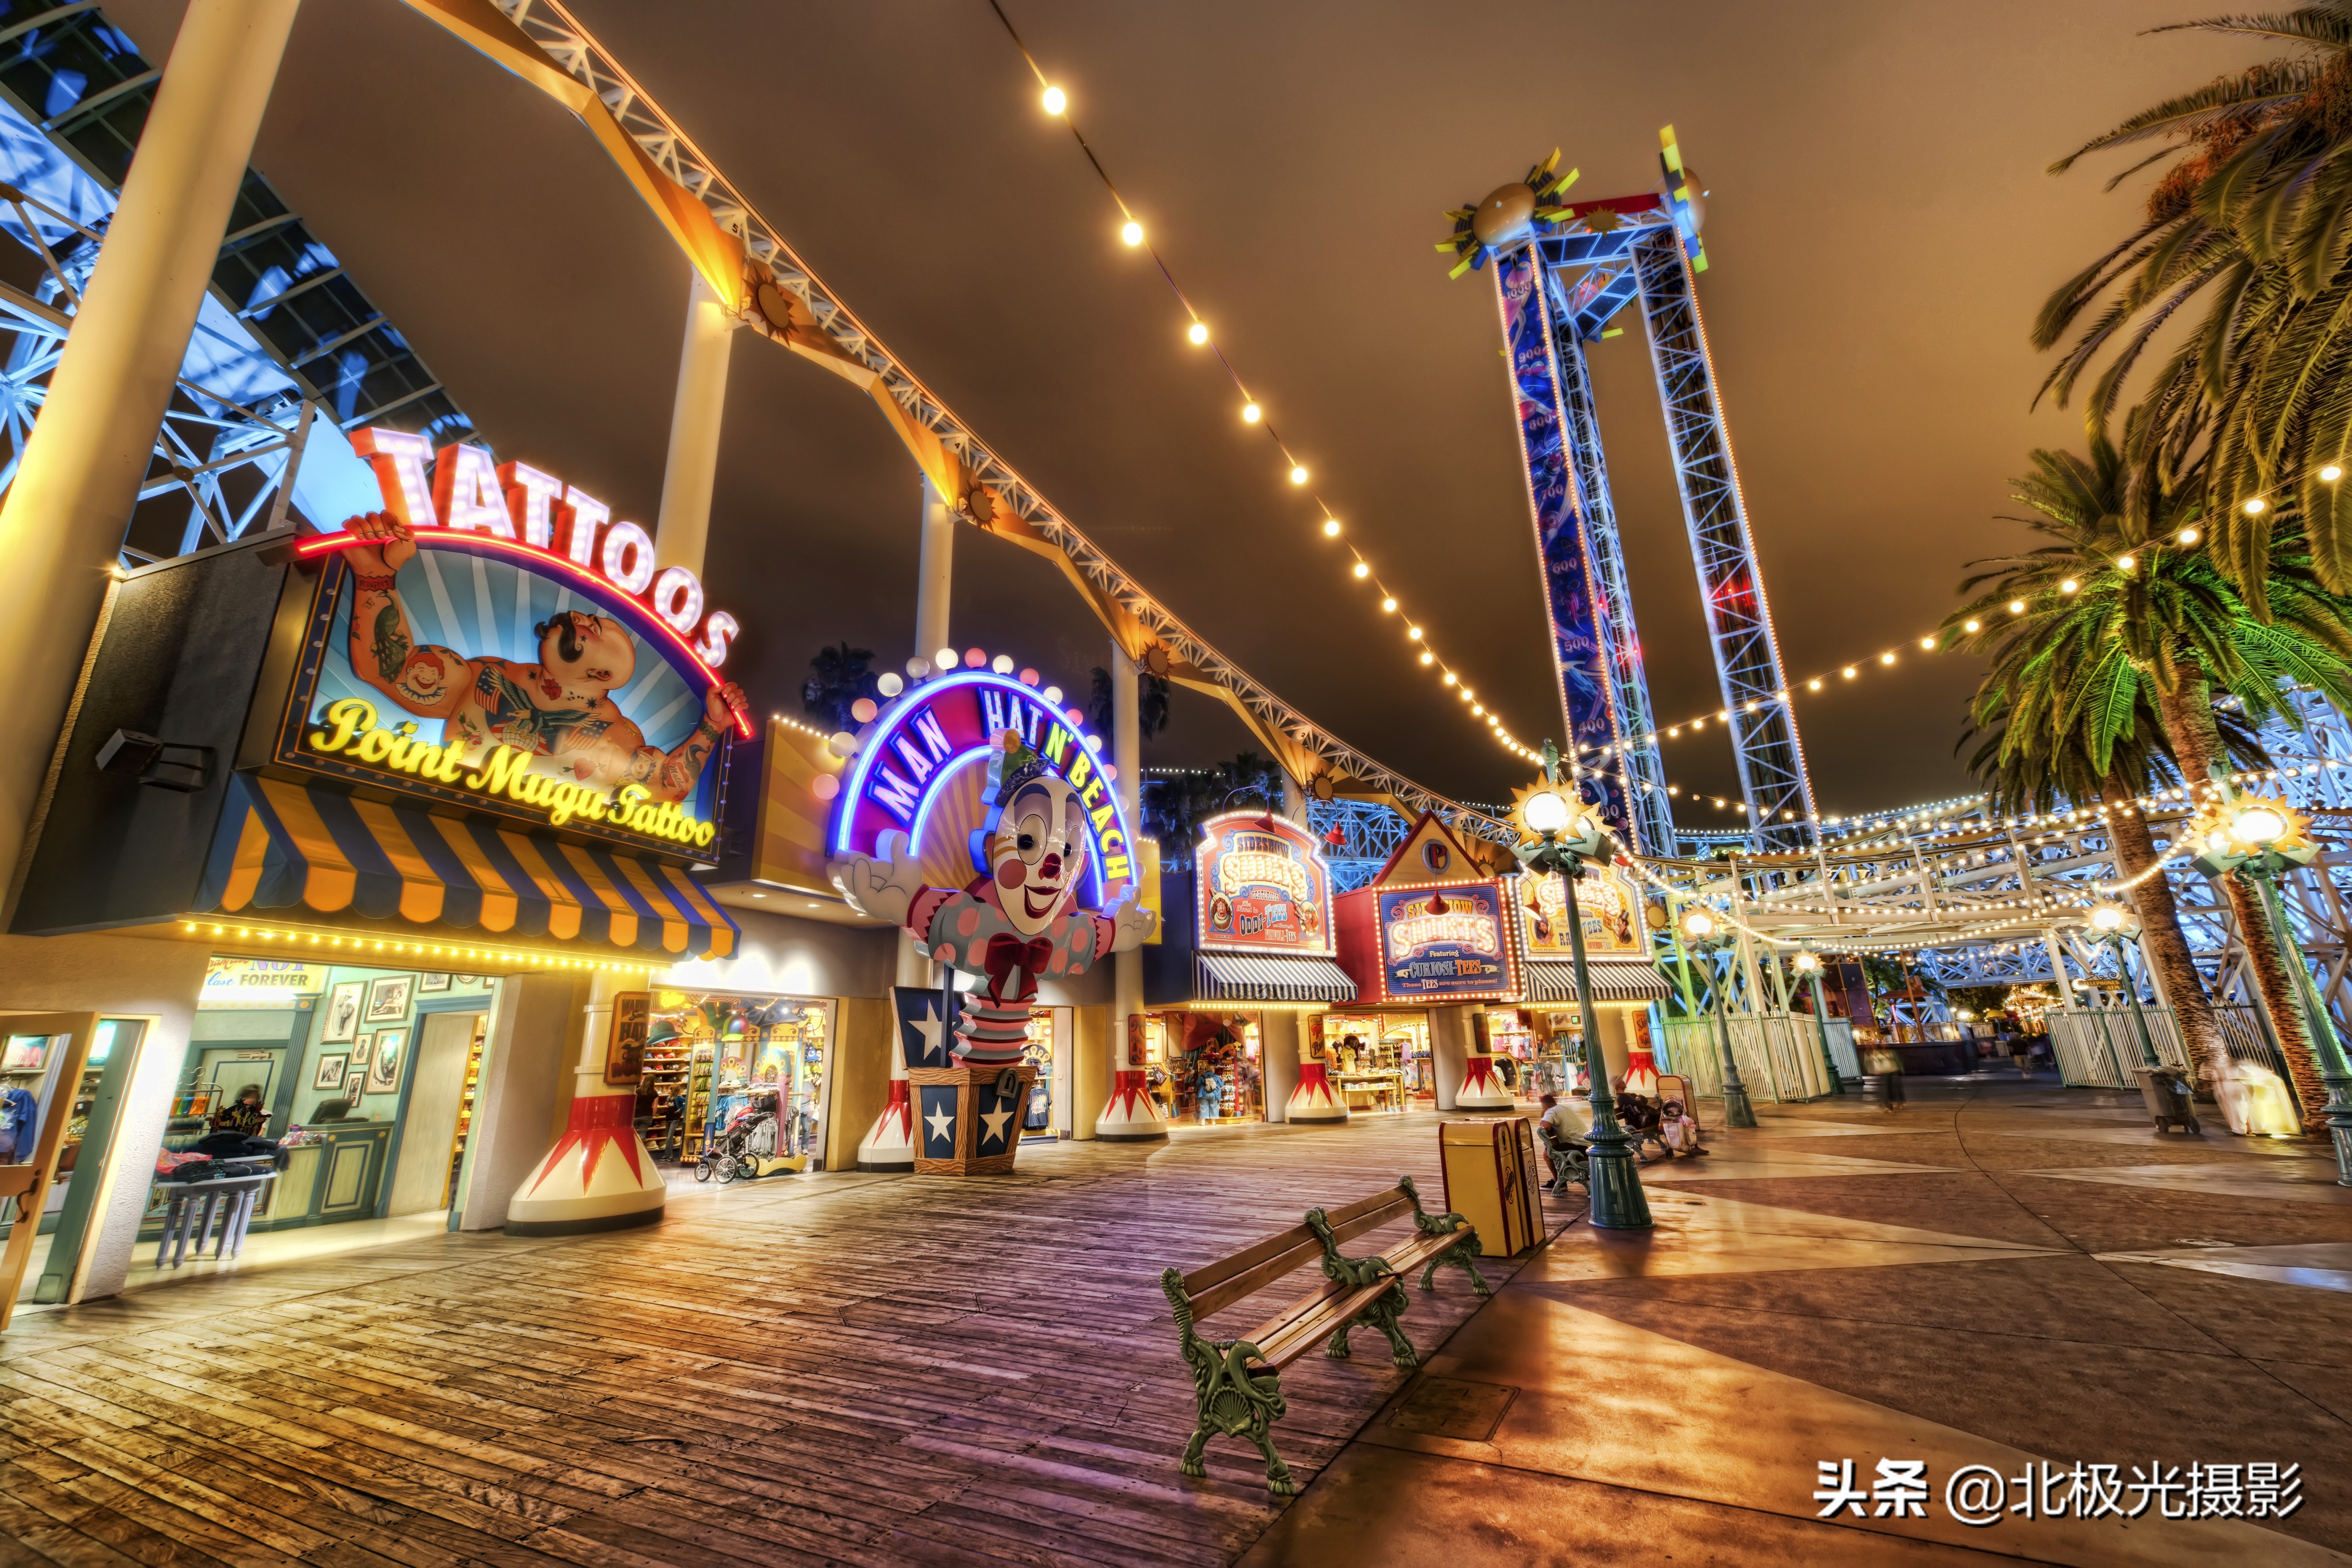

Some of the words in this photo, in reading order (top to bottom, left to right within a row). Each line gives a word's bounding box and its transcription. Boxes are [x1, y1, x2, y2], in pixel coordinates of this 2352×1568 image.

[1507, 281, 1532, 301] 1000
[1518, 346, 1541, 365] 900
[1529, 413, 1552, 431] 800
[1541, 483, 1564, 501] 700
[349, 427, 739, 668] TATTOOS
[1552, 557, 1577, 575] 600
[359, 579, 390, 588] RIGHT
[1564, 635, 1591, 654] 500
[702, 726, 714, 738] LEFT
[1578, 717, 1606, 736] 400
[310, 698, 469, 783] Point
[466, 743, 609, 825] Mugu
[607, 783, 715, 846] Tattoo
[669, 763, 685, 793] Mother
[867, 704, 954, 827] MAN
[977, 687, 1043, 749] HAT
[1066, 749, 1132, 882] BEACH
[1598, 805, 1620, 821] 00
[1237, 836, 1289, 859] SIDESHOW
[1428, 844, 1447, 868] P
[1223, 854, 1306, 901] SHIRTS
[1251, 890, 1279, 902] FEATURING
[1237, 905, 1252, 913] Finest
[1407, 899, 1473, 919] SIDHOW
[1239, 903, 1288, 936] ODDI-TEES
[1392, 916, 1496, 960] SHIRTS
[1409, 959, 1482, 978] CURIOSI-TEES
[207, 971, 235, 986] last
[239, 974, 308, 986] FOREVER
[1421, 979, 1438, 990] TEES
[205, 1116, 233, 1128] World
